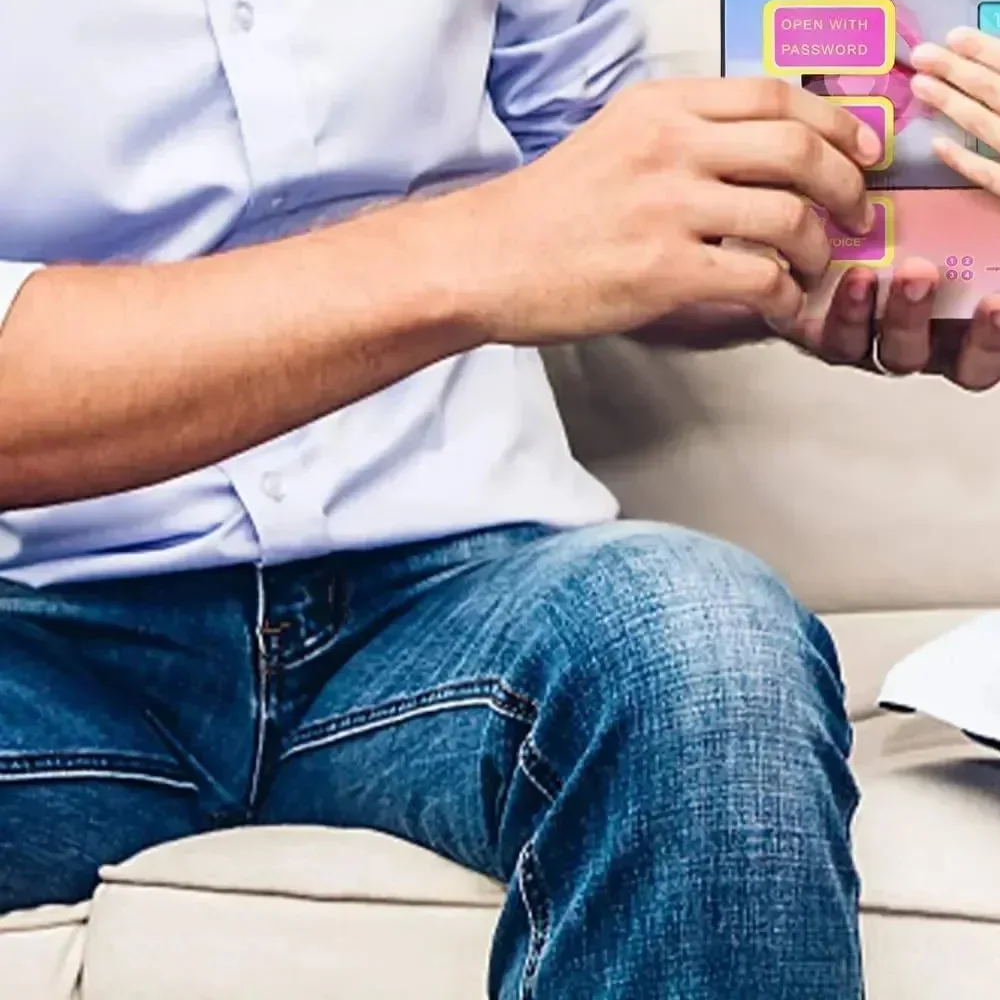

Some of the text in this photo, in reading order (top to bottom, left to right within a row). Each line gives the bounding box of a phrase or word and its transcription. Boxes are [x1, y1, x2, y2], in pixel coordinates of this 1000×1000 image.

[780, 18, 868, 31] OPEN WITH
[992, 11, 1000, 28] 1
[781, 43, 868, 56] PASSWORD
